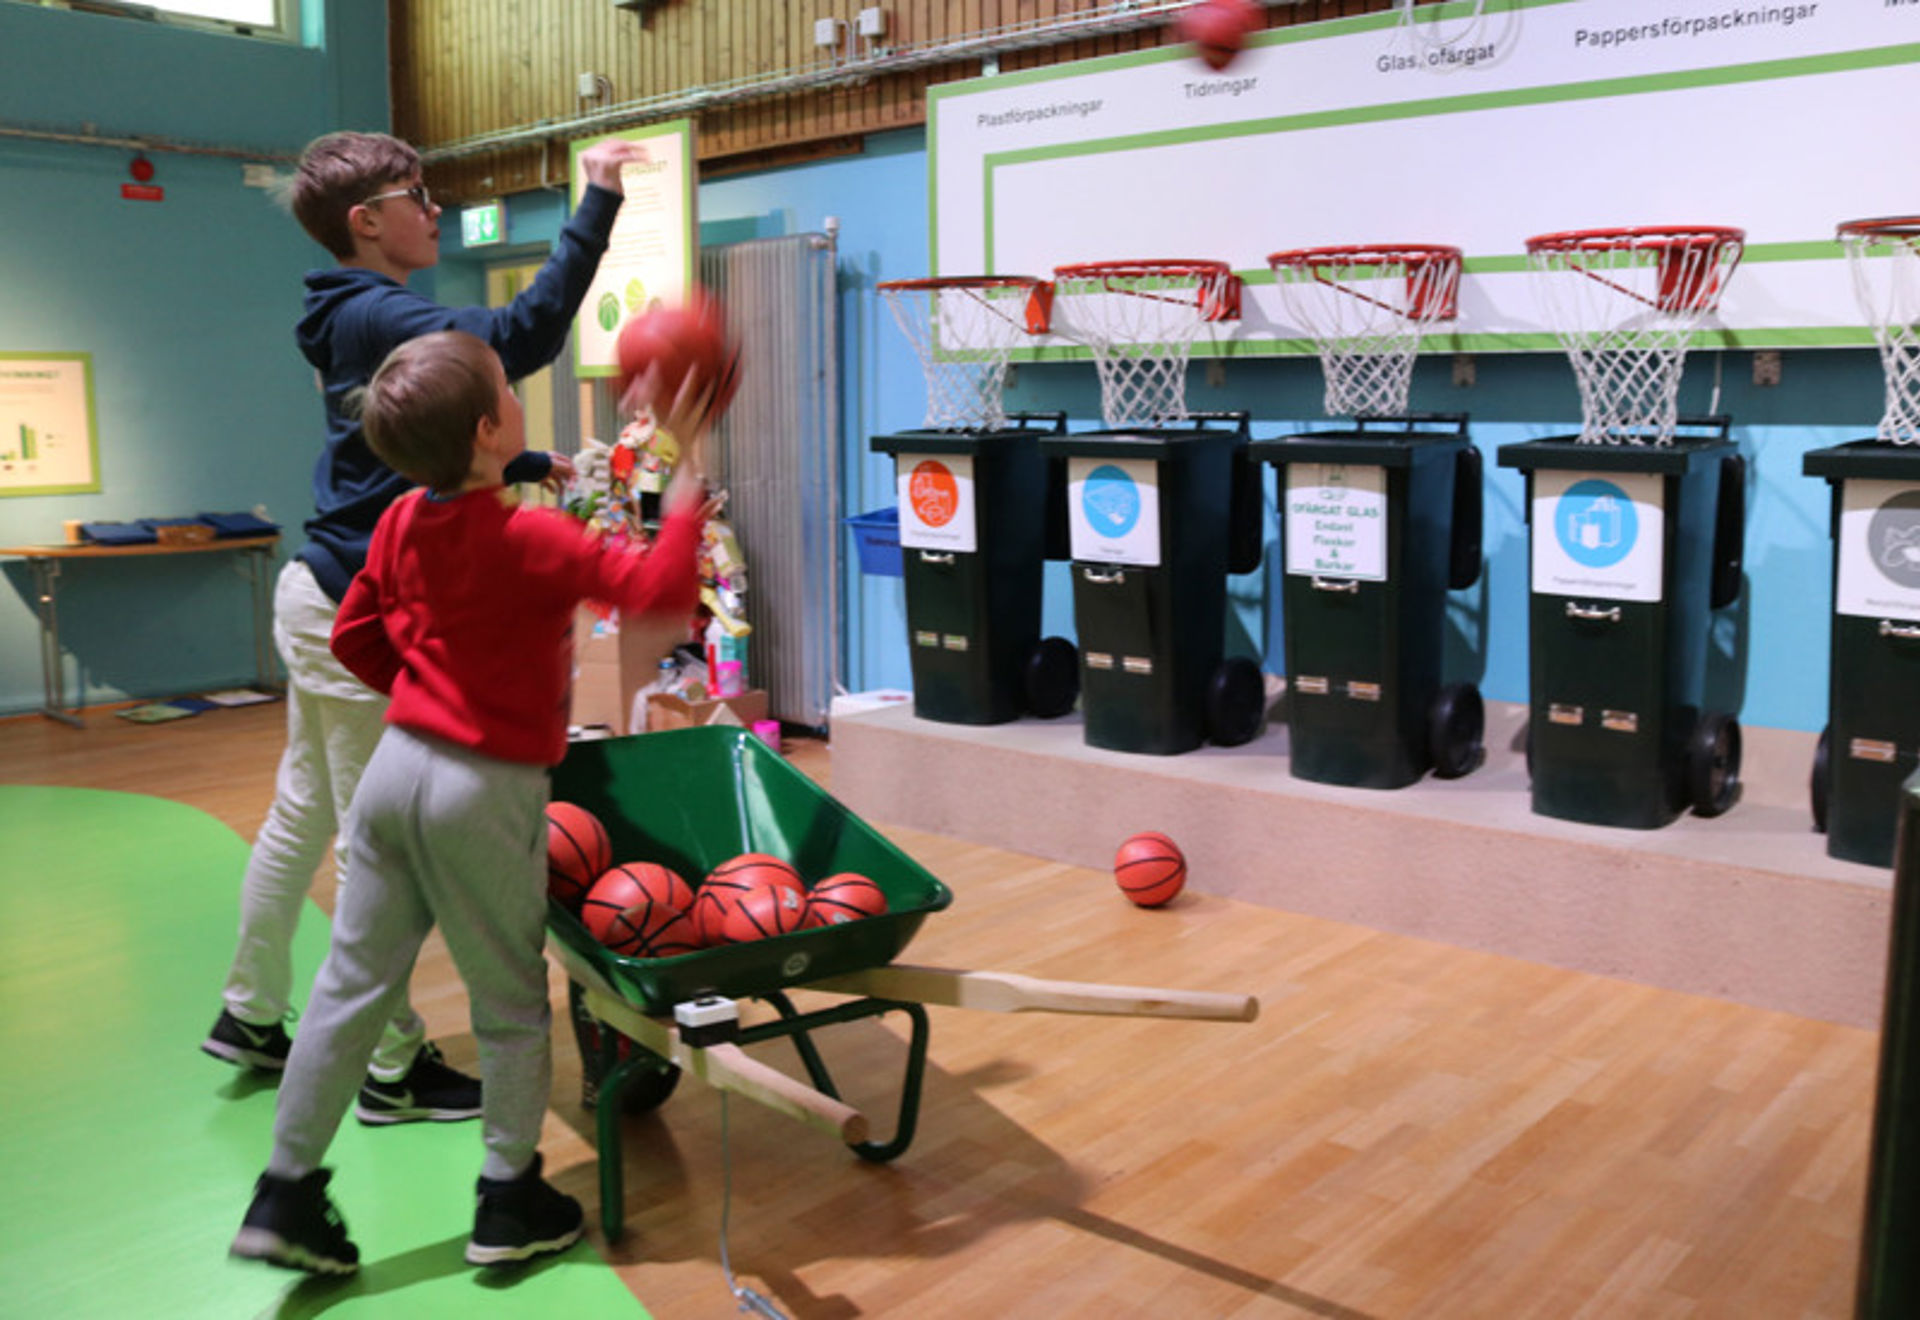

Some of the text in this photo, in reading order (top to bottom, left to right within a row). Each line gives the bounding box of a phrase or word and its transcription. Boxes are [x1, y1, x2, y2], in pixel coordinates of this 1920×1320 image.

[1574, 3, 1817, 46] Pappersförpackningar
[1184, 77, 1258, 99] Tidningar
[977, 98, 1103, 127] Plastförpackningar
